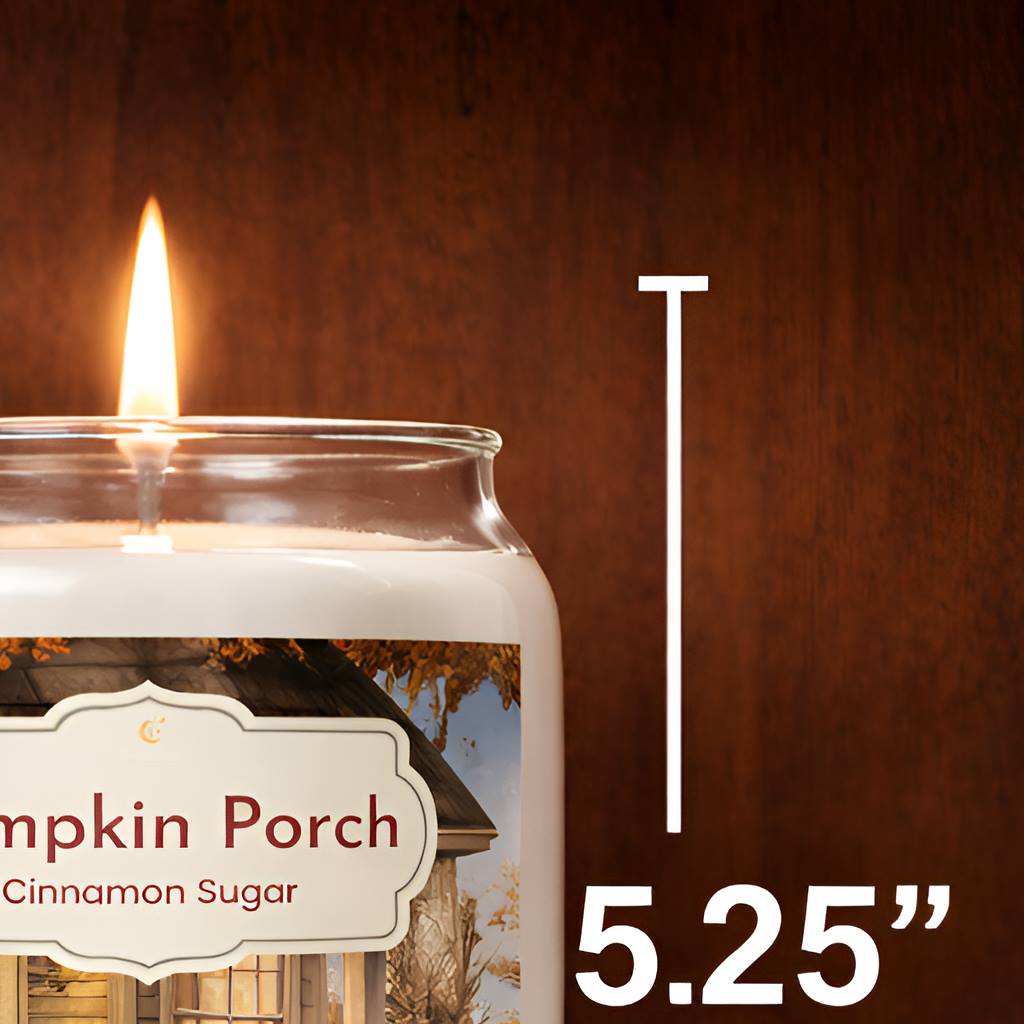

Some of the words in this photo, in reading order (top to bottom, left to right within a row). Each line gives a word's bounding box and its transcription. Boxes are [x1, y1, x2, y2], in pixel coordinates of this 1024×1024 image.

[224, 793, 399, 849] Porch
[2, 877, 185, 905] Cinnamon
[197, 878, 299, 913] Sugar
